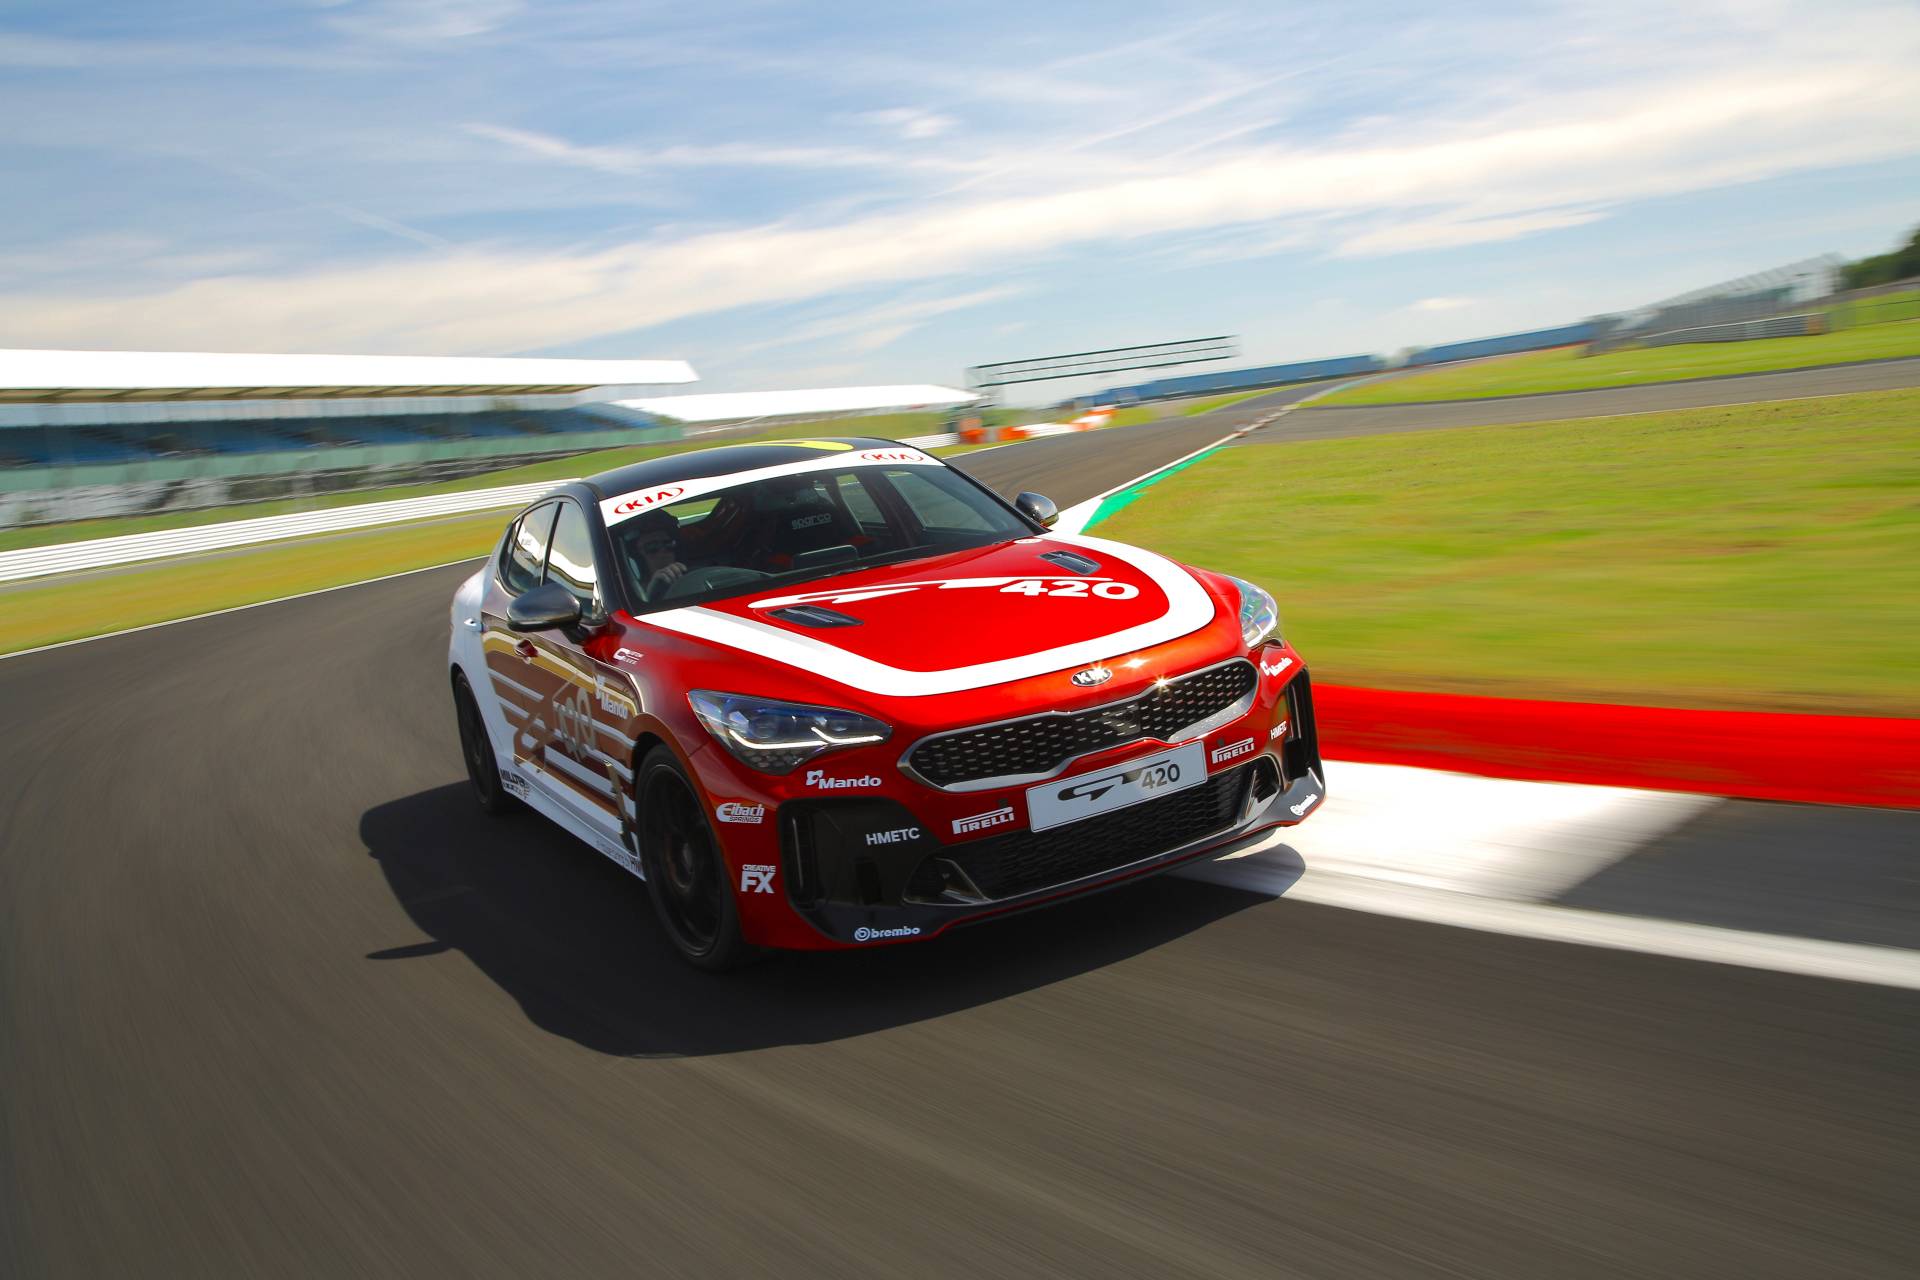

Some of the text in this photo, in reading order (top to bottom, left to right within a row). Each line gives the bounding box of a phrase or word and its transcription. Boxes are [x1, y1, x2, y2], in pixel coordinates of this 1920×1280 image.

[626, 490, 675, 511] KIA
[1000, 580, 1140, 600] 420
[1212, 737, 1255, 764] PIRELLI
[818, 775, 882, 790] Mando
[1142, 764, 1181, 790] 420
[716, 802, 765, 823] Eibach
[952, 806, 1015, 835] PIRELLI
[866, 828, 920, 845] HMETC
[742, 864, 776, 873] CREATIVE
[740, 871, 776, 893] FX
[871, 926, 920, 939] brembo
